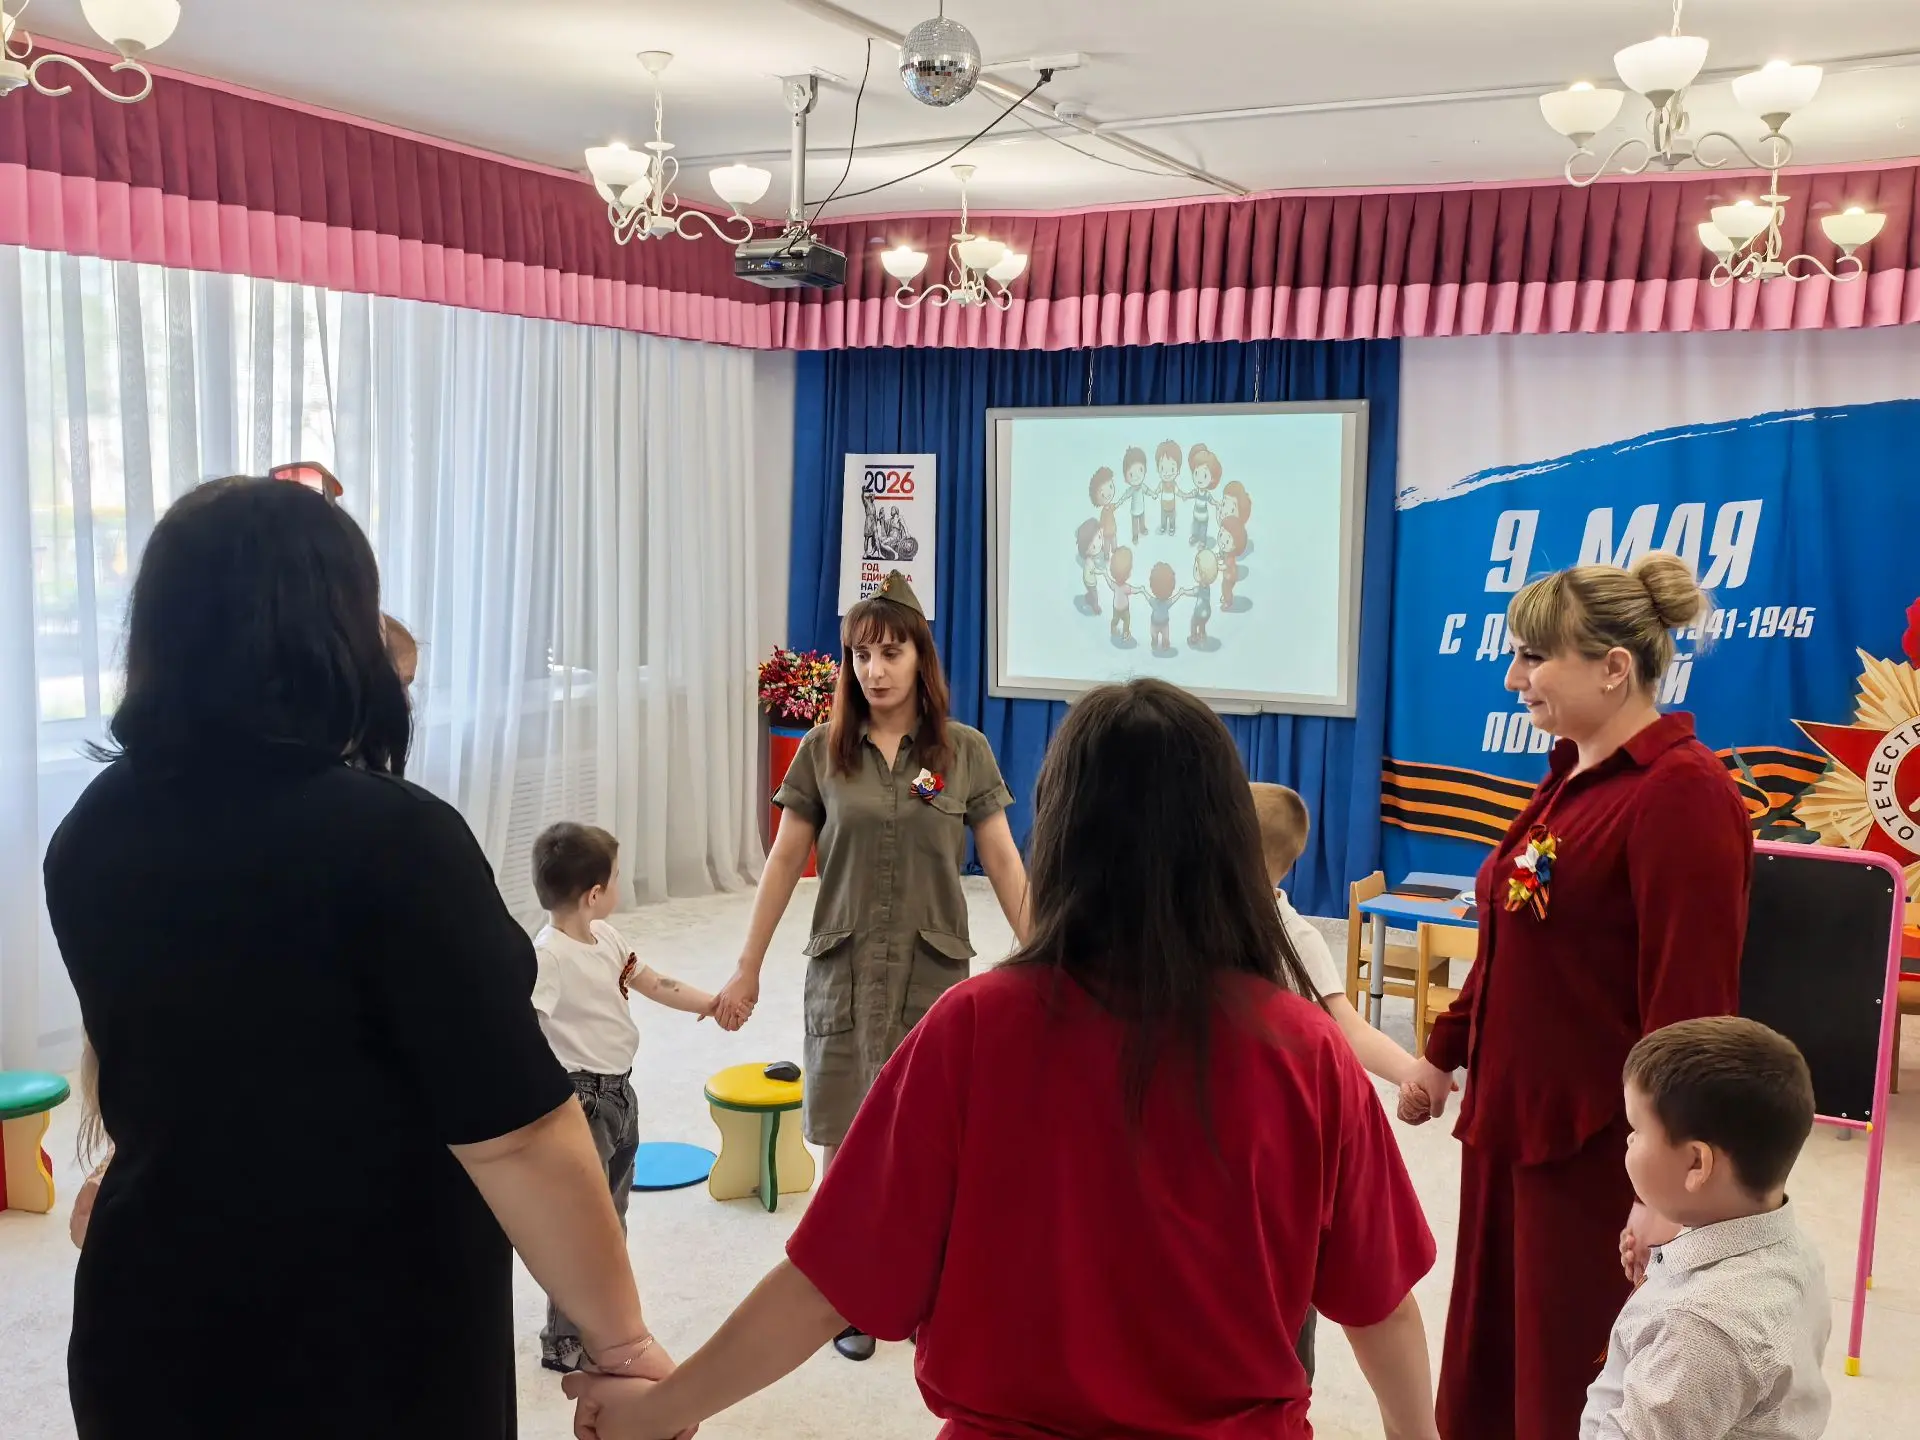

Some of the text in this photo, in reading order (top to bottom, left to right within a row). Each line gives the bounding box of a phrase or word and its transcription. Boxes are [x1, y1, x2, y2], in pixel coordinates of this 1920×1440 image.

[864, 471, 915, 494] 2026
[1484, 499, 1763, 592] 9 МАЯ
[861, 573, 912, 582] ЕДИНА
[862, 563, 879, 572] ГОД
[1439, 613, 1466, 654] С
